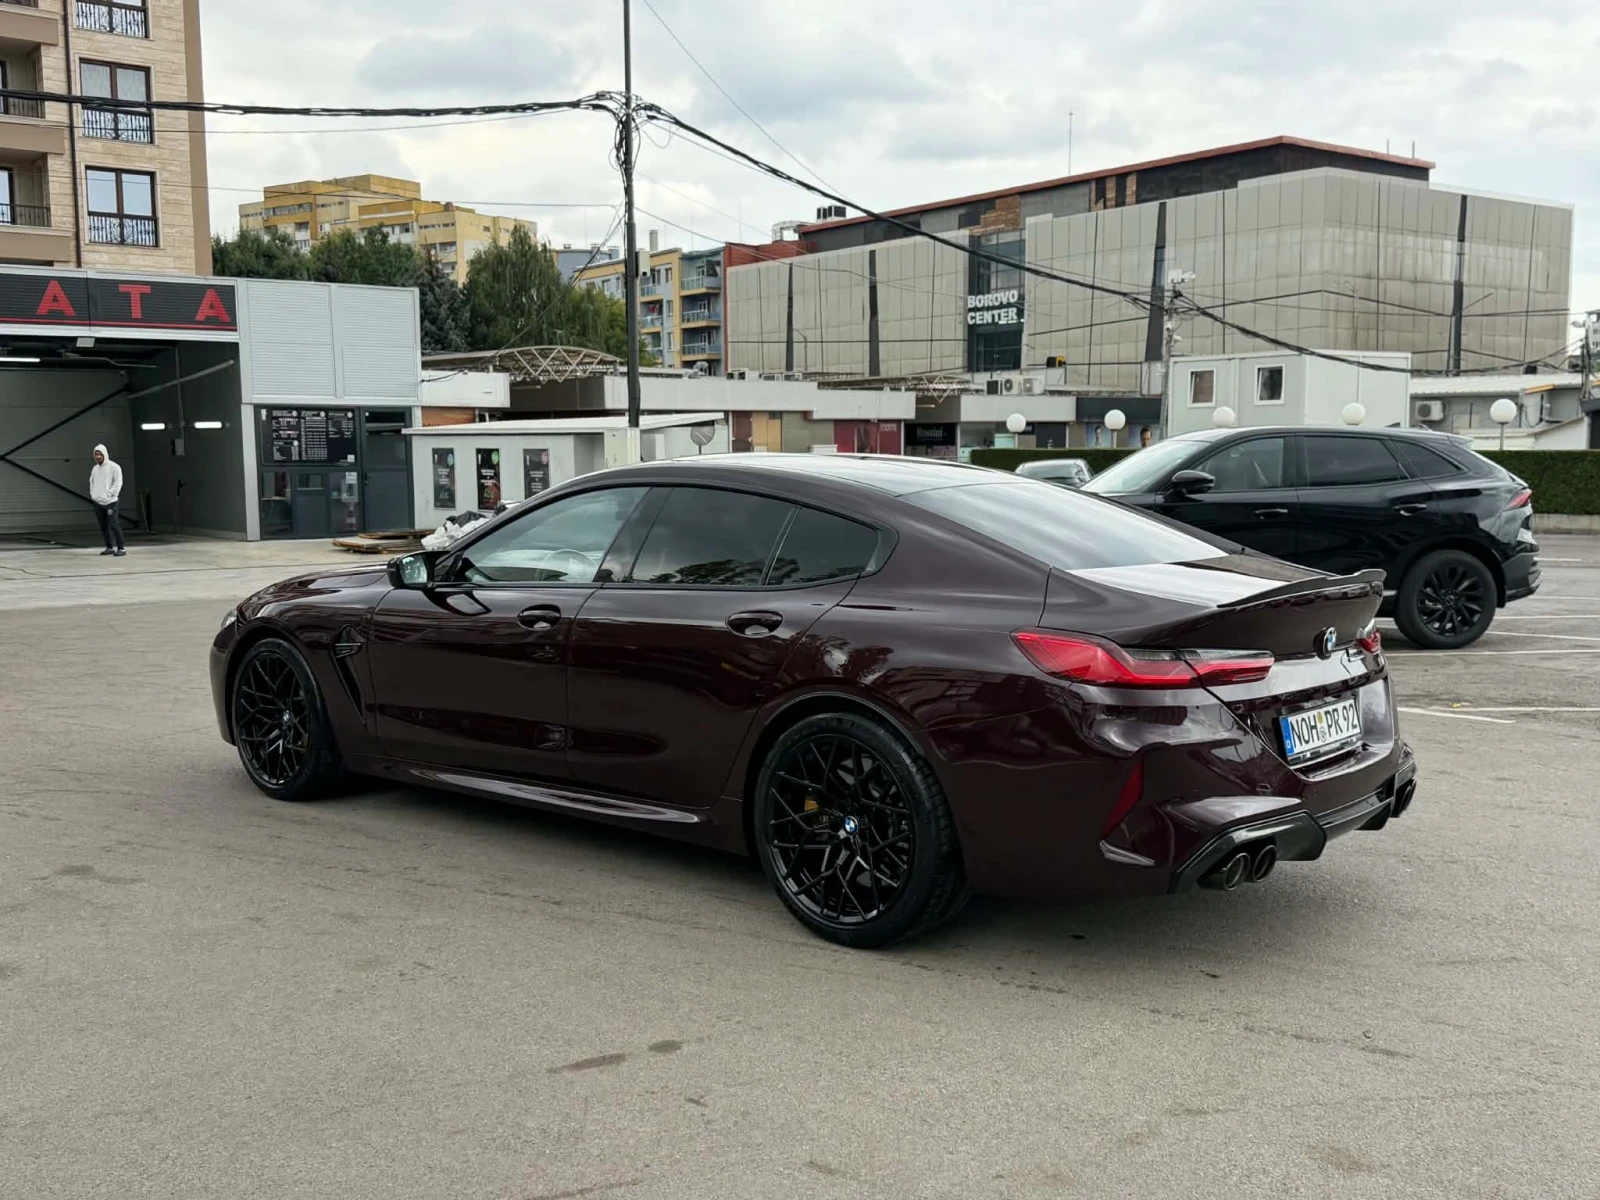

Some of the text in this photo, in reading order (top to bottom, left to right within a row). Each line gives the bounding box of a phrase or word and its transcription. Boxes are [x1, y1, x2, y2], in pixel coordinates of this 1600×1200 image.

[968, 290, 1018, 308] BOROVO
[967, 307, 1018, 325] CENTER
[1290, 714, 1320, 748] NOH
[1324, 707, 1343, 738] PR
[1342, 703, 1357, 732] 92
